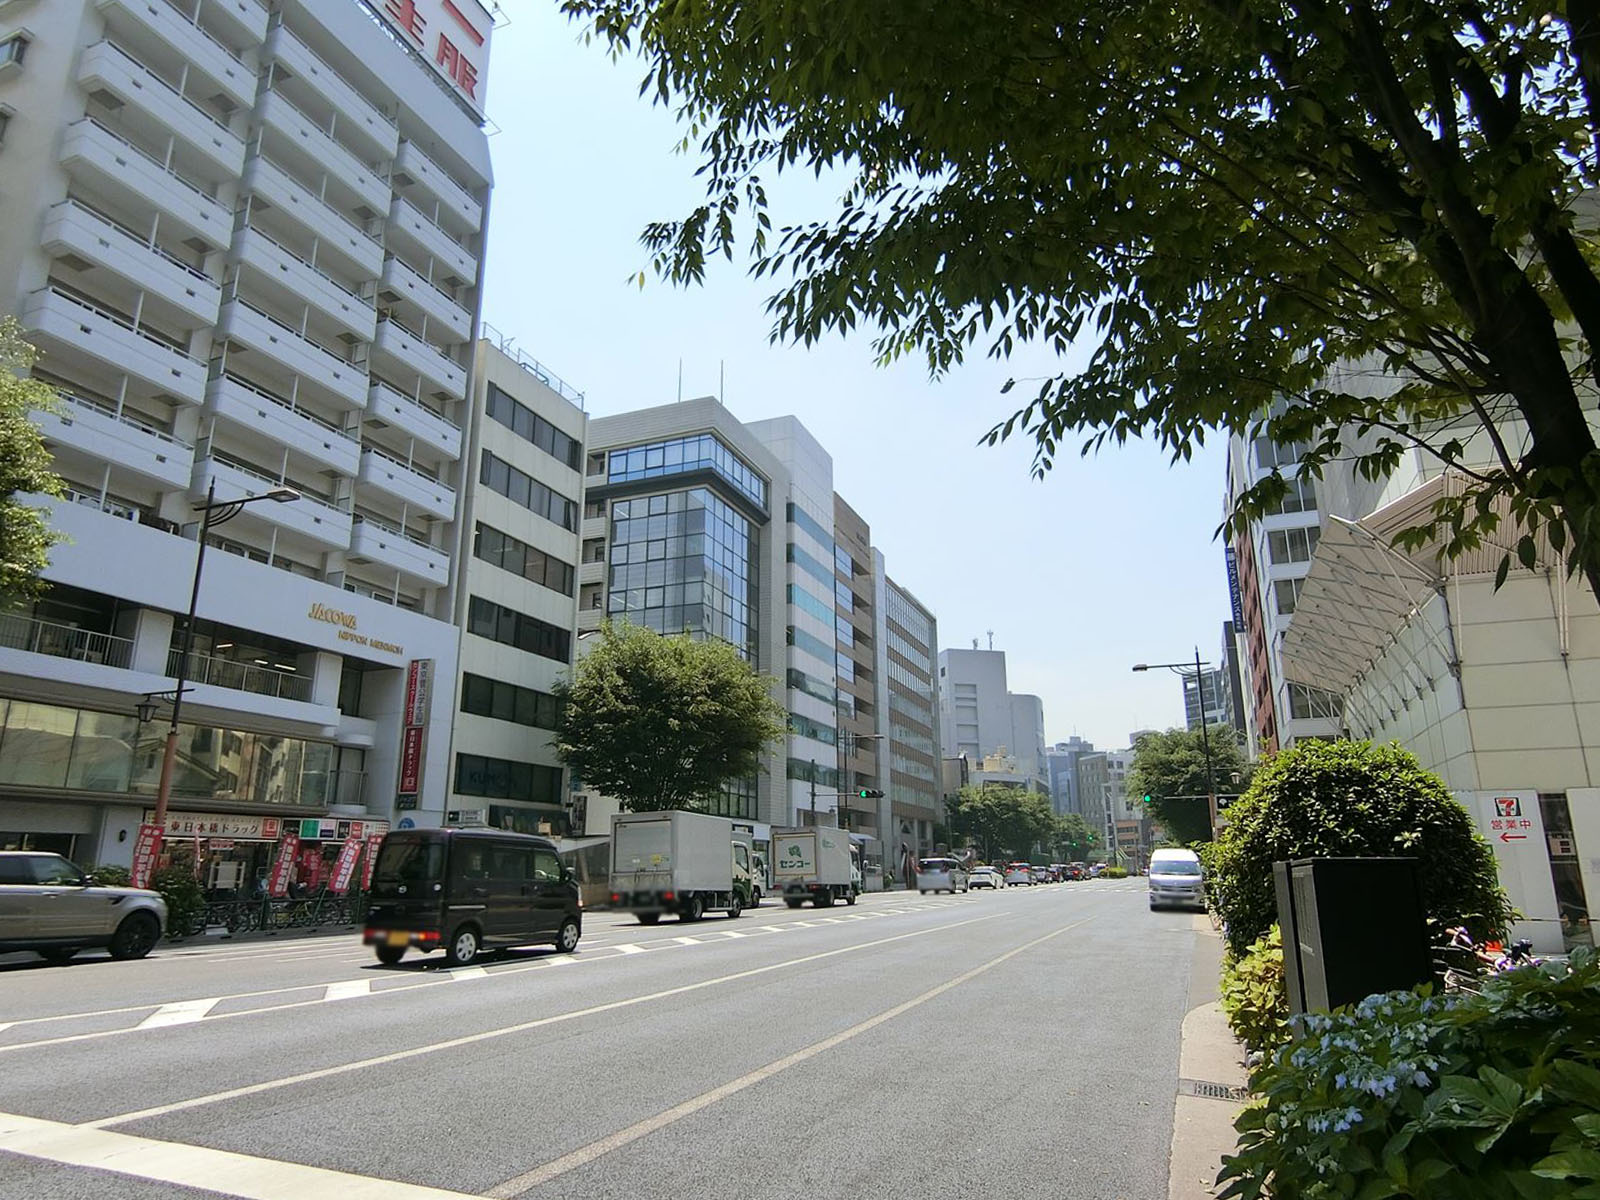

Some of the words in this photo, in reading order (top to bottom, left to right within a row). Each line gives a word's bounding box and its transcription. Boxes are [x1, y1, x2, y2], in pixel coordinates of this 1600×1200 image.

[170, 821, 259, 835] 東日本橋ドラッグ
[1491, 819, 1531, 831] 営業中
[779, 860, 810, 868] センコー
